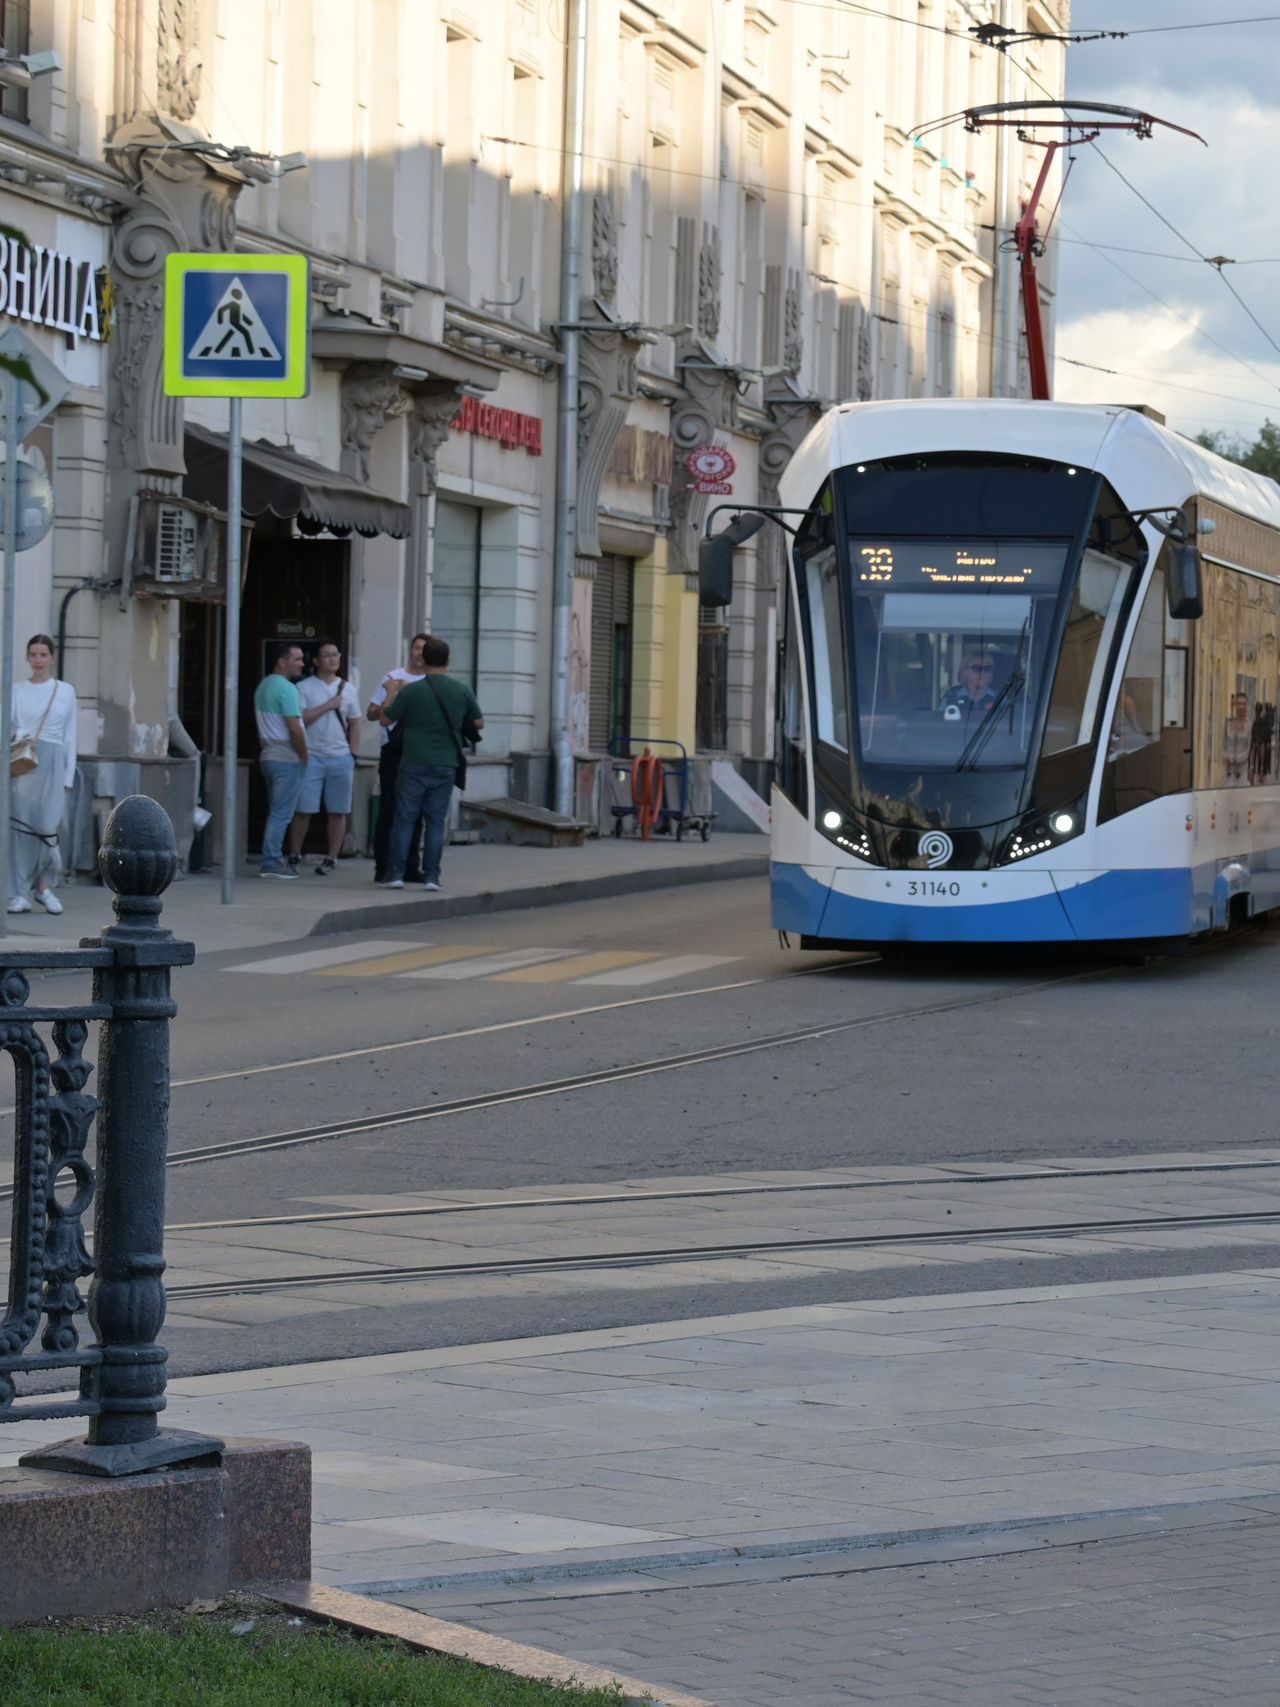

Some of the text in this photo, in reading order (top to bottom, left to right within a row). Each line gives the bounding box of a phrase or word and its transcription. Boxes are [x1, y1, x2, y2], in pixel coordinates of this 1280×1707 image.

[478, 402, 518, 450] СЕКОНД
[699, 482, 730, 494] ВИНО
[908, 881, 960, 896] 31140
